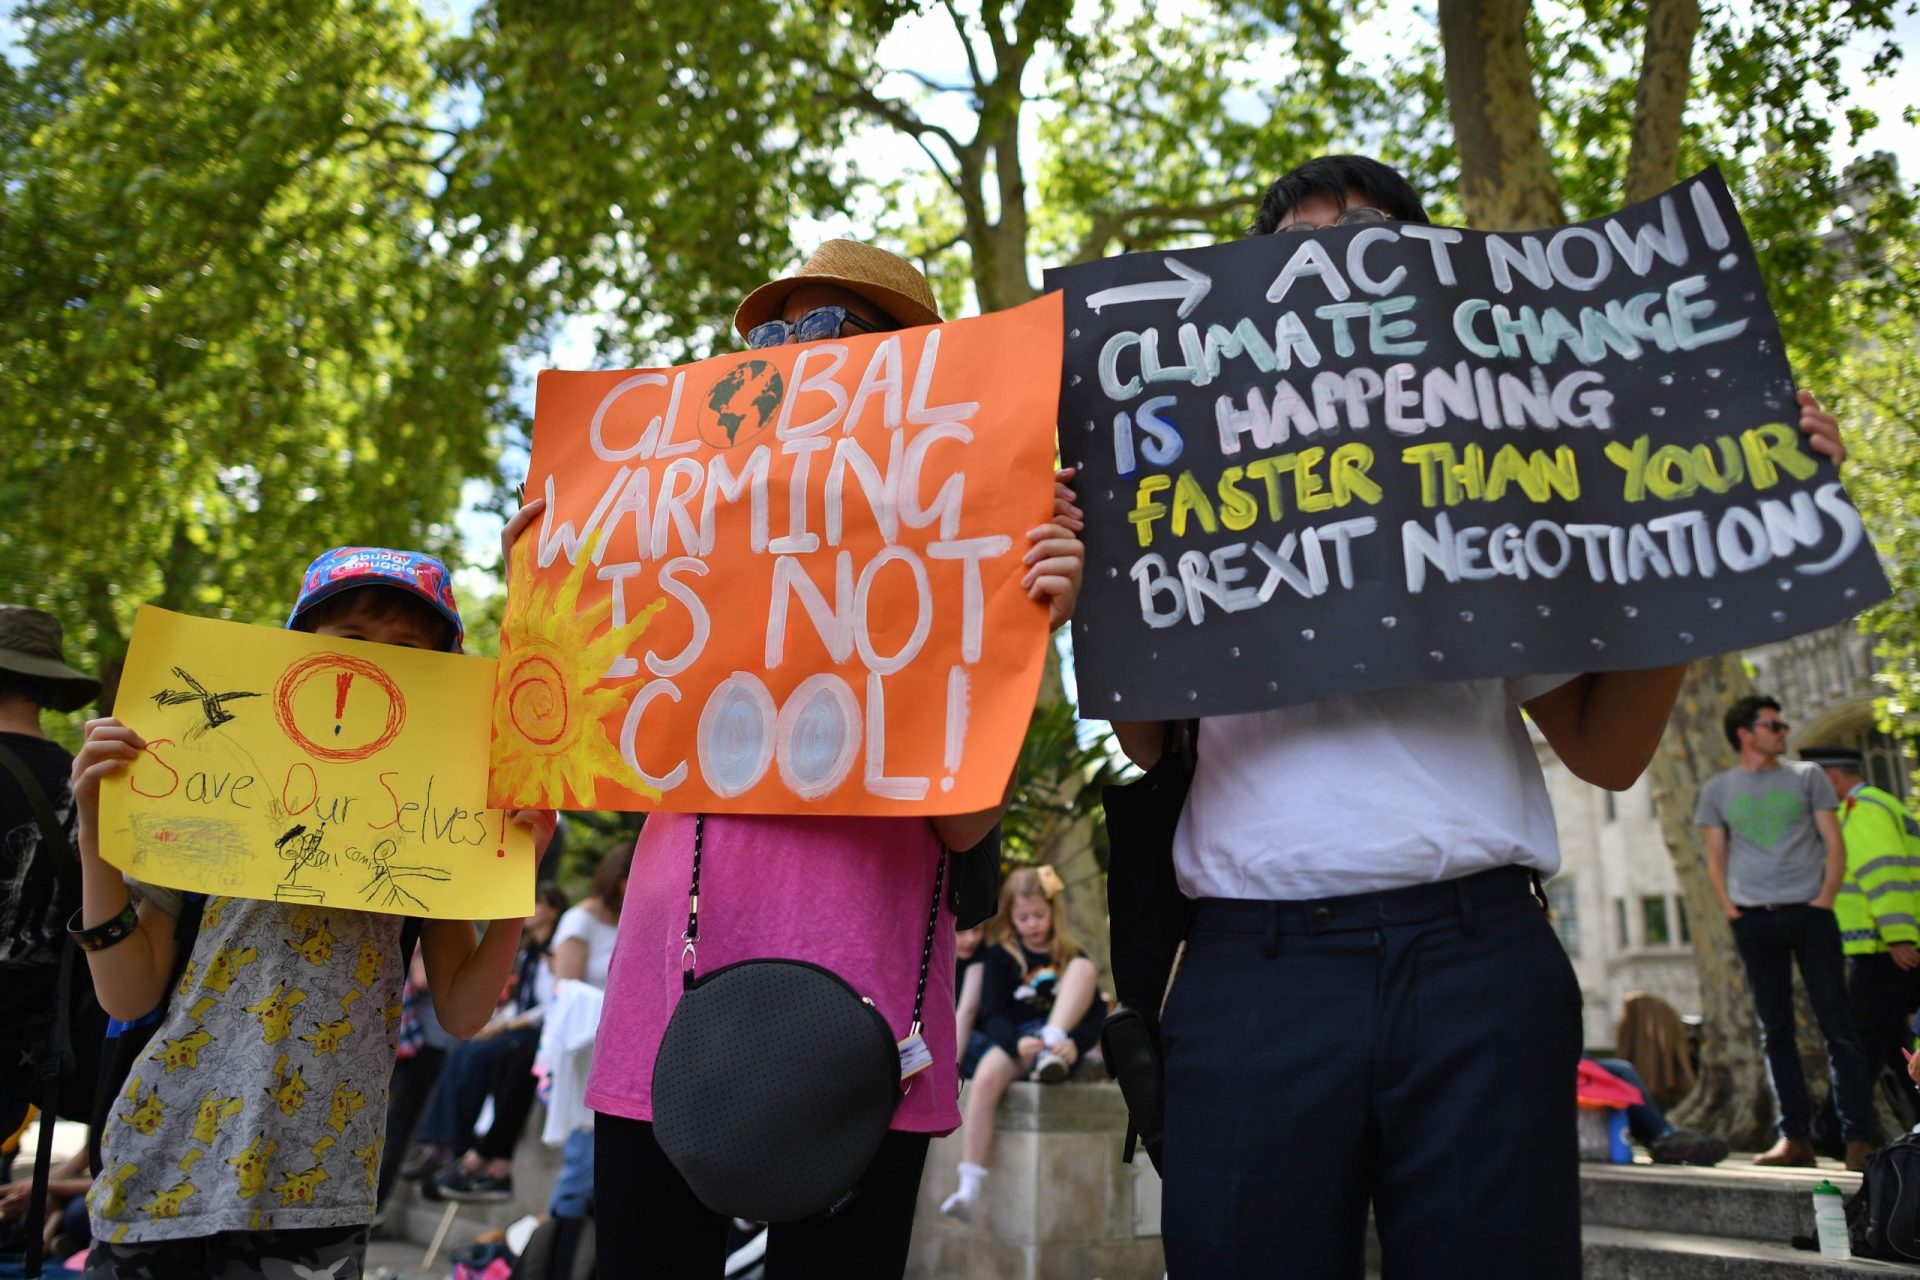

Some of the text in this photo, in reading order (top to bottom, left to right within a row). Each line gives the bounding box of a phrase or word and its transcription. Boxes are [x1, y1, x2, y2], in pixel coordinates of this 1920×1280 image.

[1266, 180, 1739, 303] ACT NOW!
[1098, 274, 1750, 401] CLIMATE CHANGE
[1113, 359, 1615, 478] IS HAPPENING
[538, 422, 975, 568] WARMING
[1127, 422, 1819, 548] FASTER THAN YOUR
[596, 534, 1012, 678] IS NOT
[1128, 483, 1864, 630] BREXIT NEGOTIATIONS
[130, 738, 254, 809] Save
[282, 762, 358, 825] Our
[619, 665, 971, 801] COOL!
